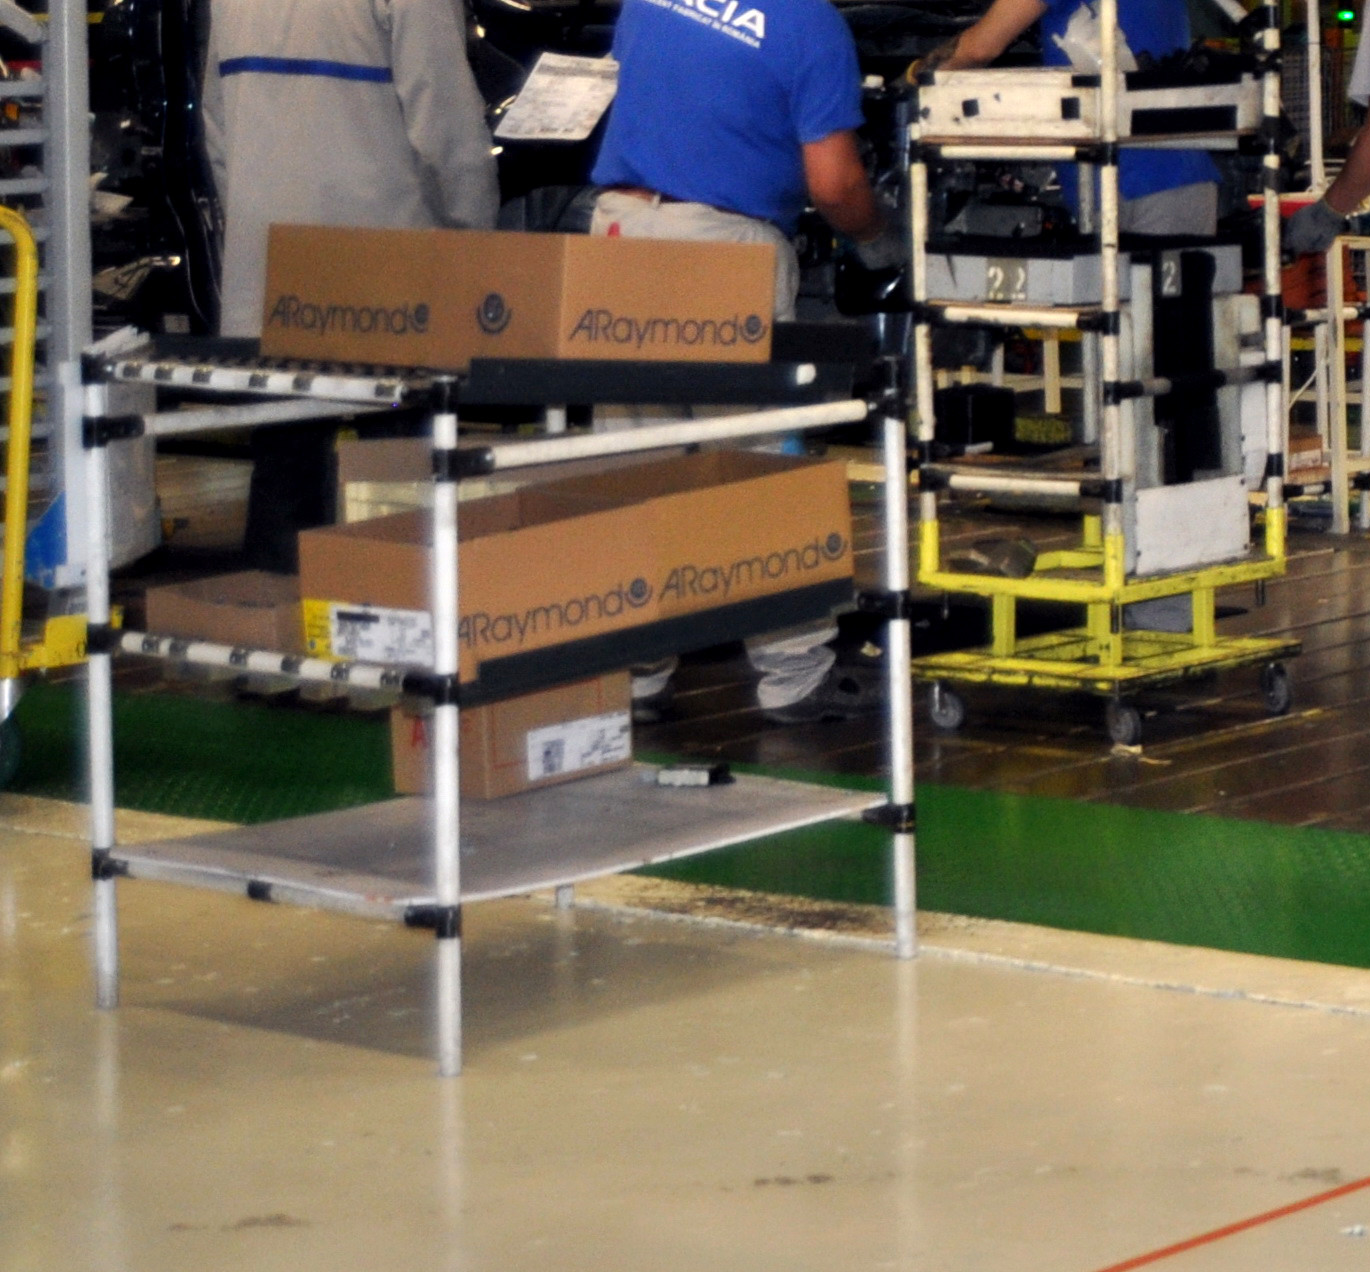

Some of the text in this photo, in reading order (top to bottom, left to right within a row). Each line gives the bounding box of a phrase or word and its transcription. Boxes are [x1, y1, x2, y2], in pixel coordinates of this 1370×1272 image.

[1162, 260, 1177, 294] 2
[269, 294, 411, 334] ARaymond
[568, 308, 740, 350] ARaymond
[658, 542, 821, 602] ARaymond
